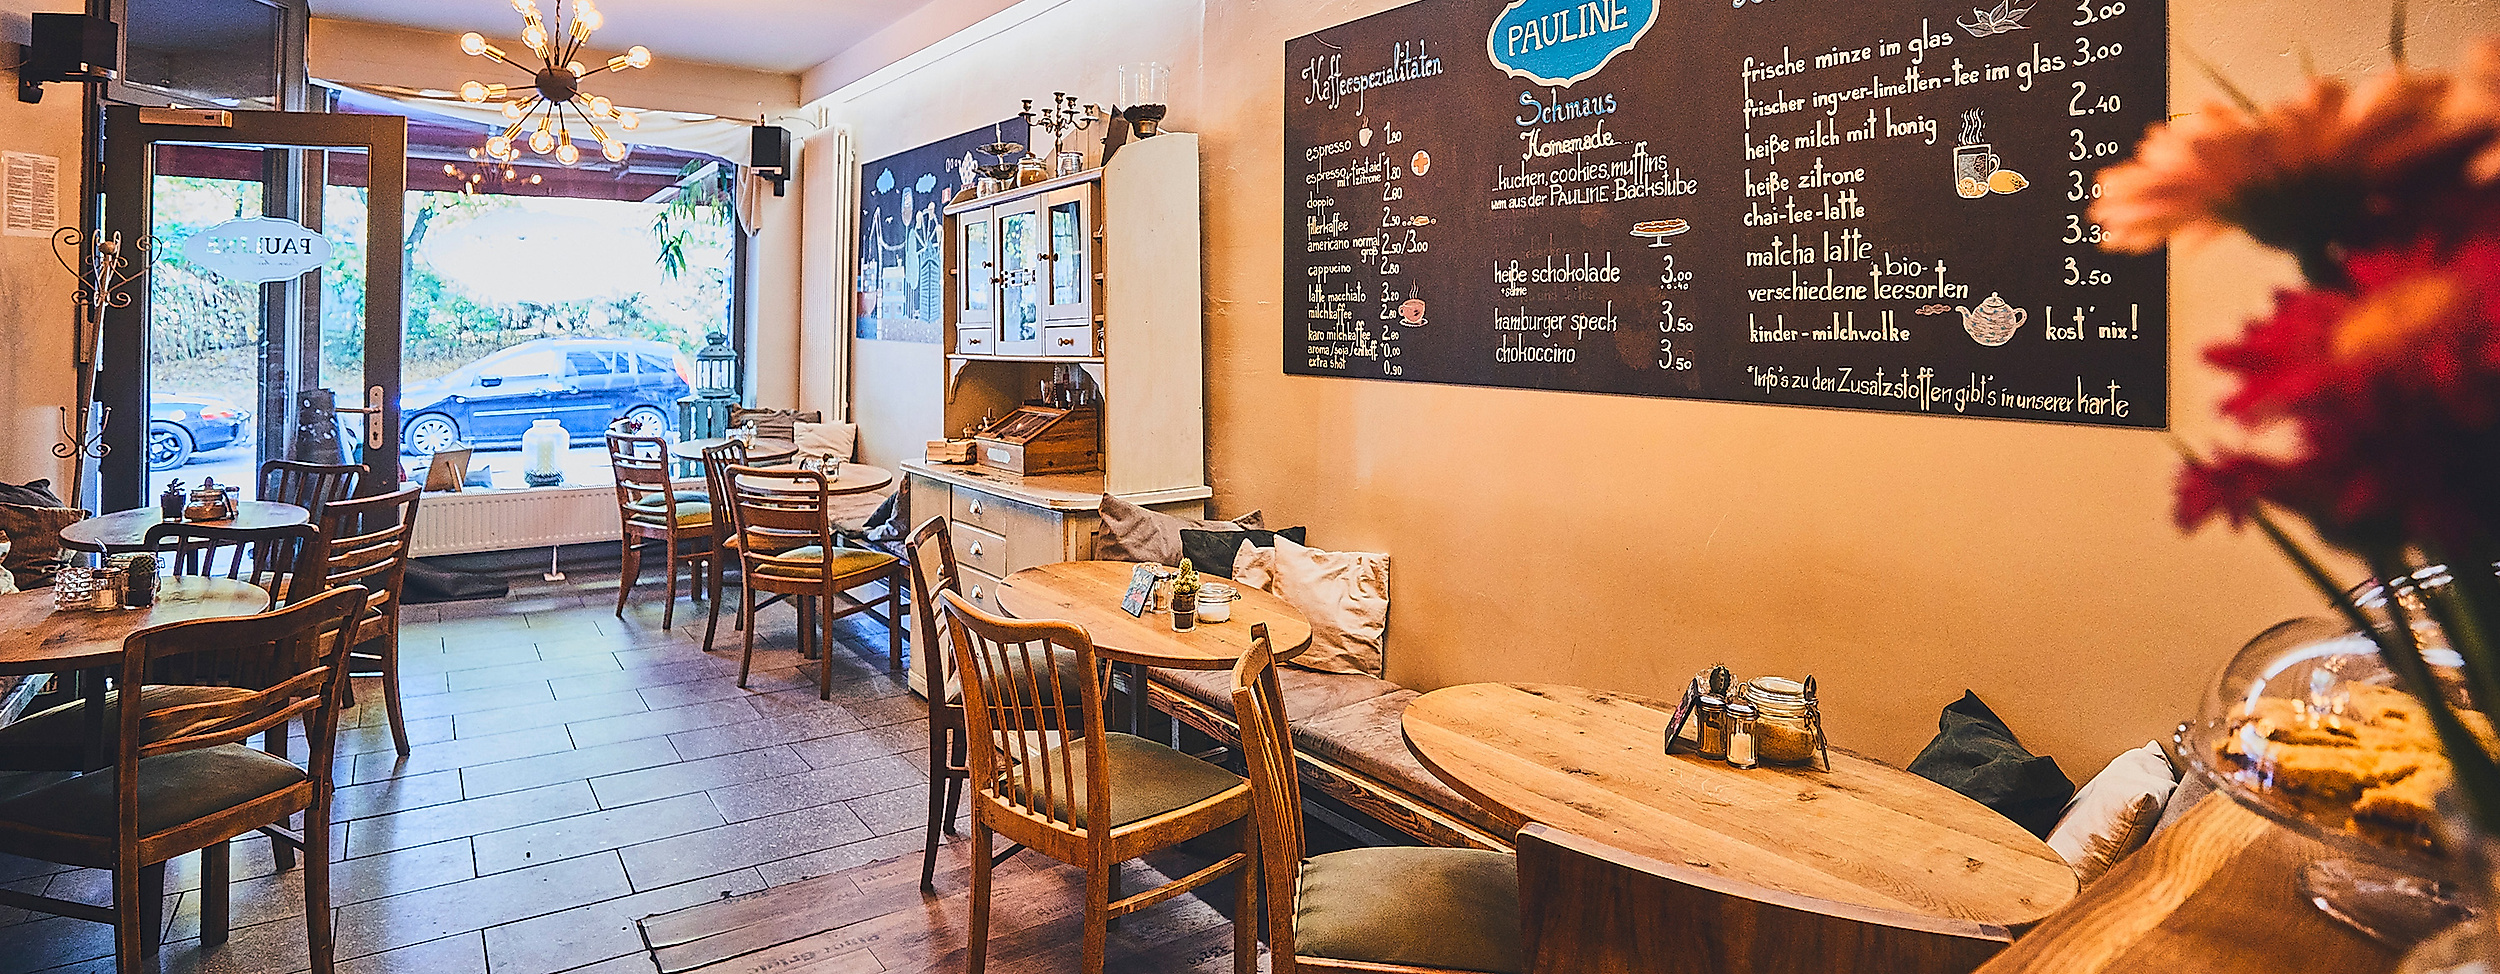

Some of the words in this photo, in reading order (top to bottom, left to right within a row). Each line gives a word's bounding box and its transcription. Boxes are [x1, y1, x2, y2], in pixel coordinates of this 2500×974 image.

[1508, 0, 1629, 56] PAULINE
[1302, 39, 1443, 116] Kaffeespezialitäten
[1742, 45, 1805, 100] frische
[1815, 47, 1871, 69] minze
[1879, 39, 1901, 57] im
[1907, 17, 1954, 64] glas
[1743, 90, 1806, 130] frischer
[1985, 63, 2009, 81] im
[2016, 42, 2066, 92] glas
[2073, 37, 2123, 67] 3.00
[1516, 87, 1617, 126] Schmaus
[1744, 132, 1790, 165] heiße
[1795, 117, 1840, 149] milch
[1846, 108, 1877, 142] mit
[1886, 106, 1937, 145] honig
[2069, 81, 2121, 116] 2.40
[1306, 140, 1352, 173] espresso
[1611, 141, 1667, 185] muffins
[1745, 168, 1790, 204] heiße
[1798, 156, 1866, 188] zitrone
[2069, 129, 2118, 161] 3.00
[1306, 167, 1347, 193] espresso
[1508, 197, 1527, 208] aus
[1528, 186, 1548, 207] der
[1307, 191, 1335, 216] doppio
[1307, 237, 1350, 252] americano
[1353, 228, 1380, 248] normal
[1746, 233, 1815, 267] matcha
[1823, 227, 1873, 263] latte
[2062, 214, 2111, 244] 3.30
[1308, 262, 1351, 283] cappucino
[1494, 260, 1527, 290] heiße
[1531, 251, 1621, 283] schokolade
[1661, 254, 1694, 284] 3.00
[1748, 267, 1868, 302] verschiedene
[1870, 259, 1969, 300] teesorten
[2063, 256, 2112, 286] 3.50
[1885, 252, 1928, 277] bio-
[1328, 281, 1367, 303] macchiato
[1308, 322, 1325, 341] karo
[1326, 320, 1371, 346] milchkaffee
[1494, 305, 1567, 338] hamburger
[1570, 300, 1618, 340] speck
[1659, 300, 1694, 332] 3.50
[2098, 303, 2139, 340] nix!
[1308, 355, 1328, 368] extra
[1329, 352, 1346, 369] shot
[1496, 332, 1576, 363] chokoccino
[1658, 338, 1692, 371] 3.50
[1791, 375, 1809, 389] zu
[1811, 366, 1836, 393] den
[1837, 366, 1953, 412] Zusatzstoffen
[2001, 387, 2014, 408] in
[2016, 393, 2075, 413] unserer
[2077, 375, 2129, 418] karte
